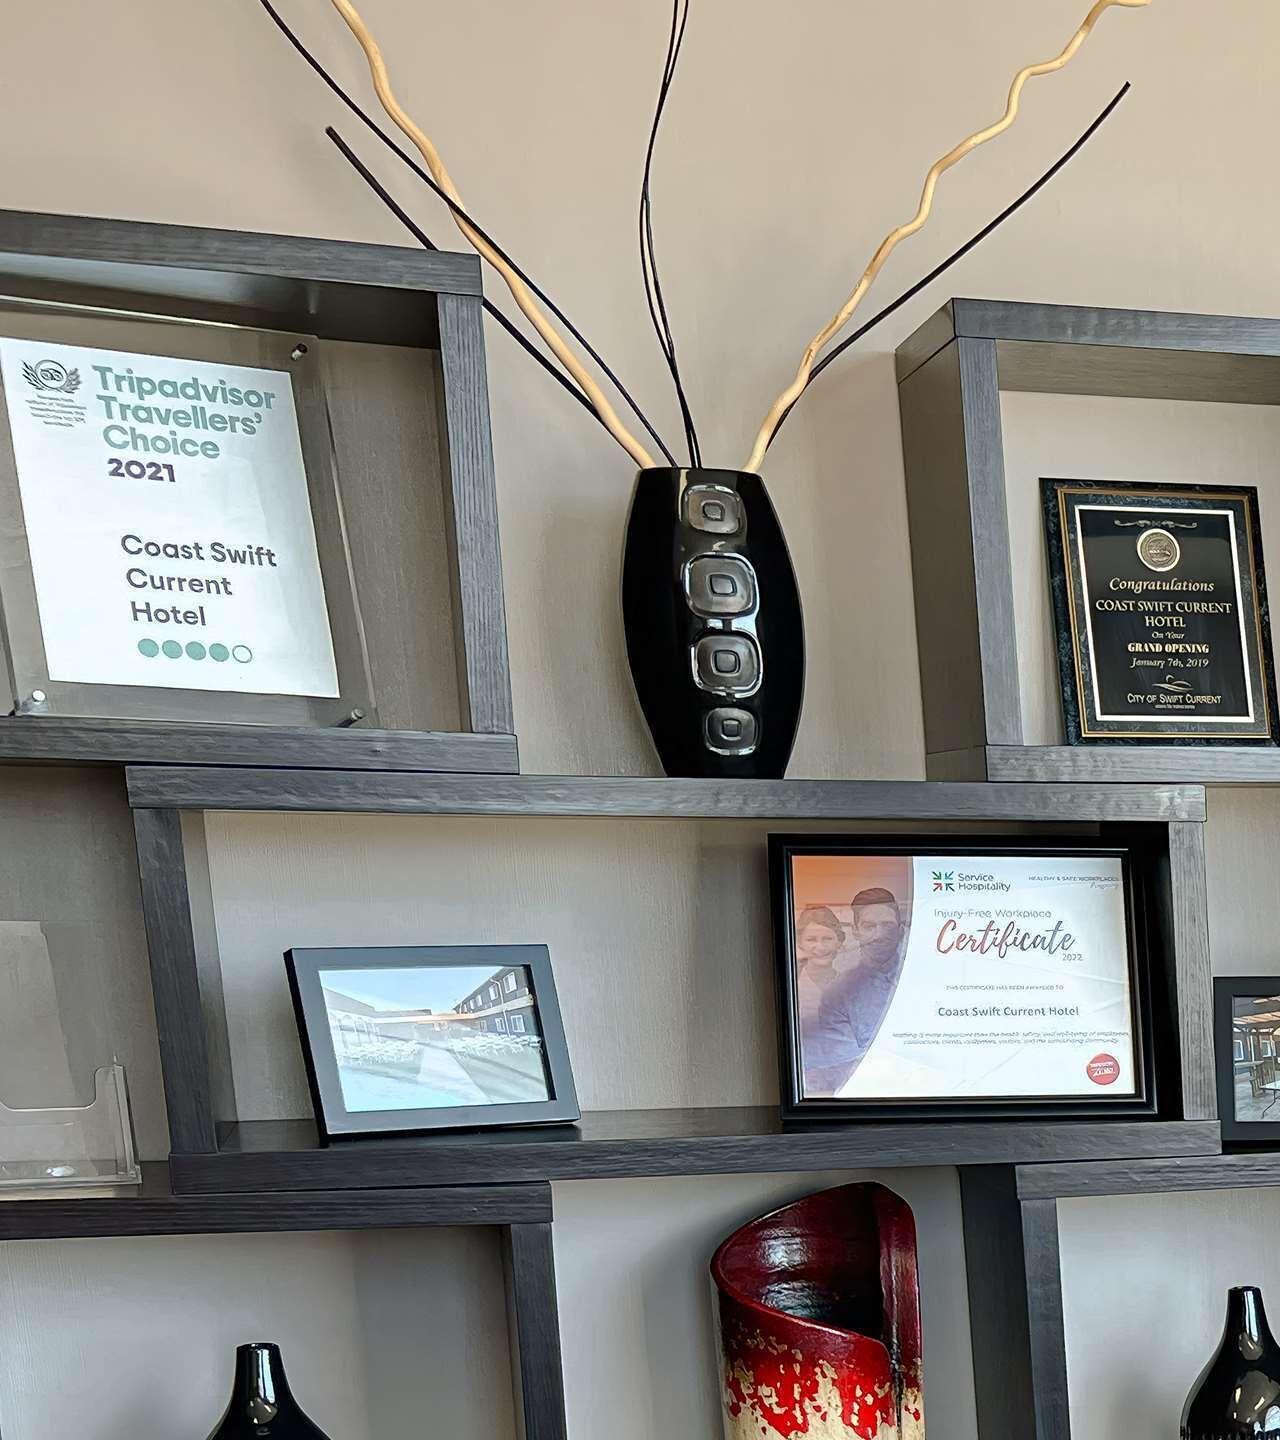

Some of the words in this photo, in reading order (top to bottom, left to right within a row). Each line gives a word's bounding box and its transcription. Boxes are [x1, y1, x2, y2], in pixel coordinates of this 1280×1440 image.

[92, 365, 275, 409] Tripadvisor
[103, 424, 220, 459] Choice
[107, 458, 176, 482] 2021
[121, 534, 204, 561] Coast
[210, 542, 277, 567] Swift
[126, 568, 233, 595] Current
[1109, 577, 1215, 594] Congratulations
[131, 600, 206, 626] Hotel
[1096, 599, 1135, 612] COAST
[1138, 601, 1174, 612] SWIFT
[1175, 602, 1233, 614] CURRENT
[1145, 615, 1187, 627] HOTEL
[1152, 631, 1164, 639] On
[1165, 631, 1185, 639] Your
[1127, 642, 1163, 653] GRAND
[1164, 643, 1209, 653] OPENING
[1130, 657, 1165, 669] January
[1167, 658, 1184, 667] 7th,
[1186, 658, 1209, 667] 2019
[957, 872, 994, 882] Service
[958, 882, 1011, 892] Hospitality
[934, 908, 992, 919] Injury-Free
[995, 909, 1052, 919] Workplace
[936, 919, 1076, 959] Certificate
[938, 1007, 969, 1016] Coast
[972, 1007, 1001, 1016] Swift
[1003, 1006, 1046, 1016] Current
[1049, 1006, 1079, 1016] Hotel
